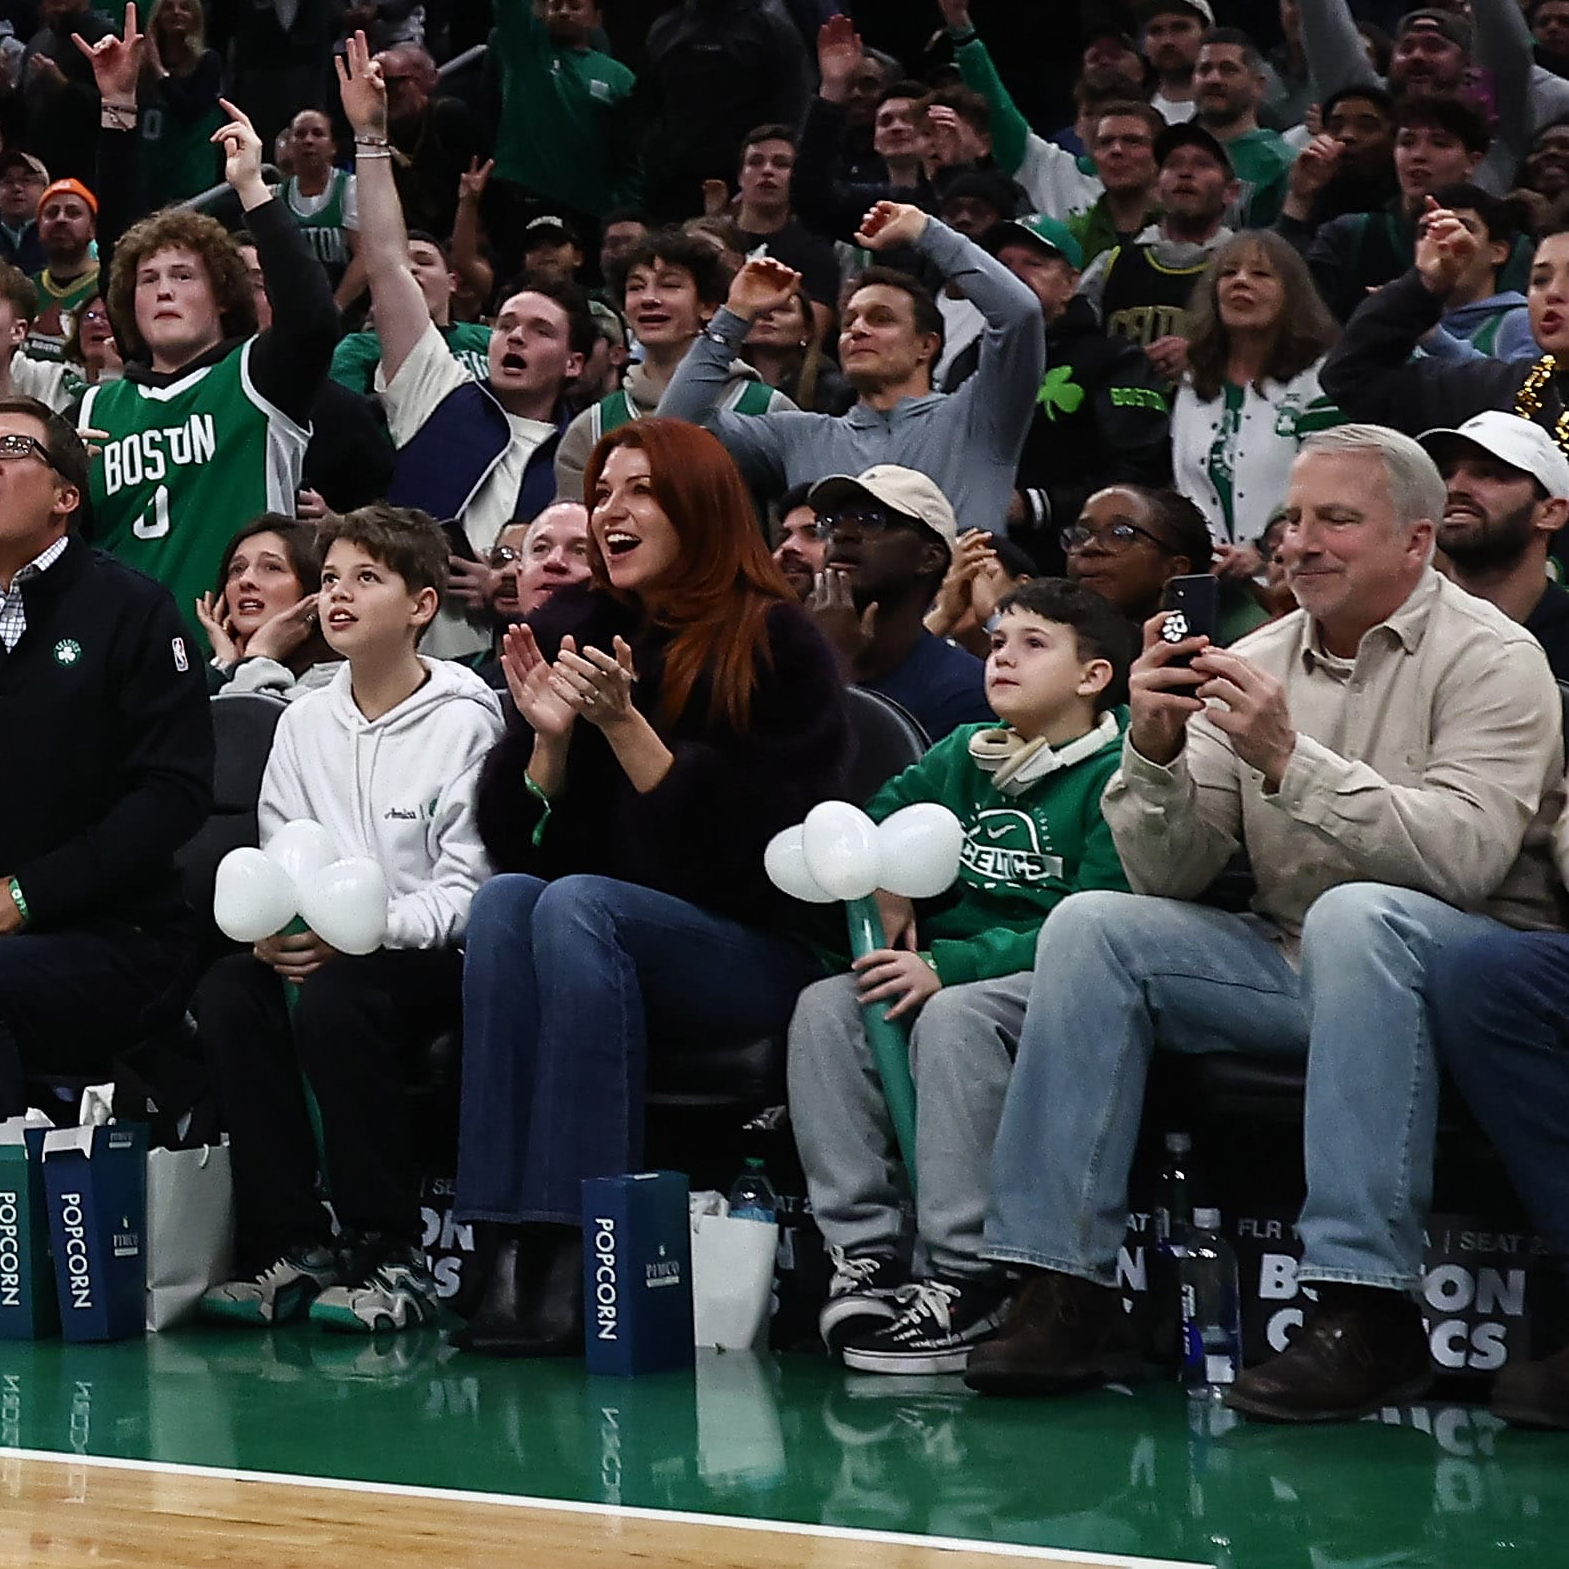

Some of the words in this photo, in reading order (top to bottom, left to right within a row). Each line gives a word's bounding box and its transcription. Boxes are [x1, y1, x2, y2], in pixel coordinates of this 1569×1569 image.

[103, 413, 217, 497] BOSTON
[60, 1192, 93, 1309] POPCORN
[1237, 1216, 1282, 1240] FLR
[594, 1216, 619, 1342] POPCORN
